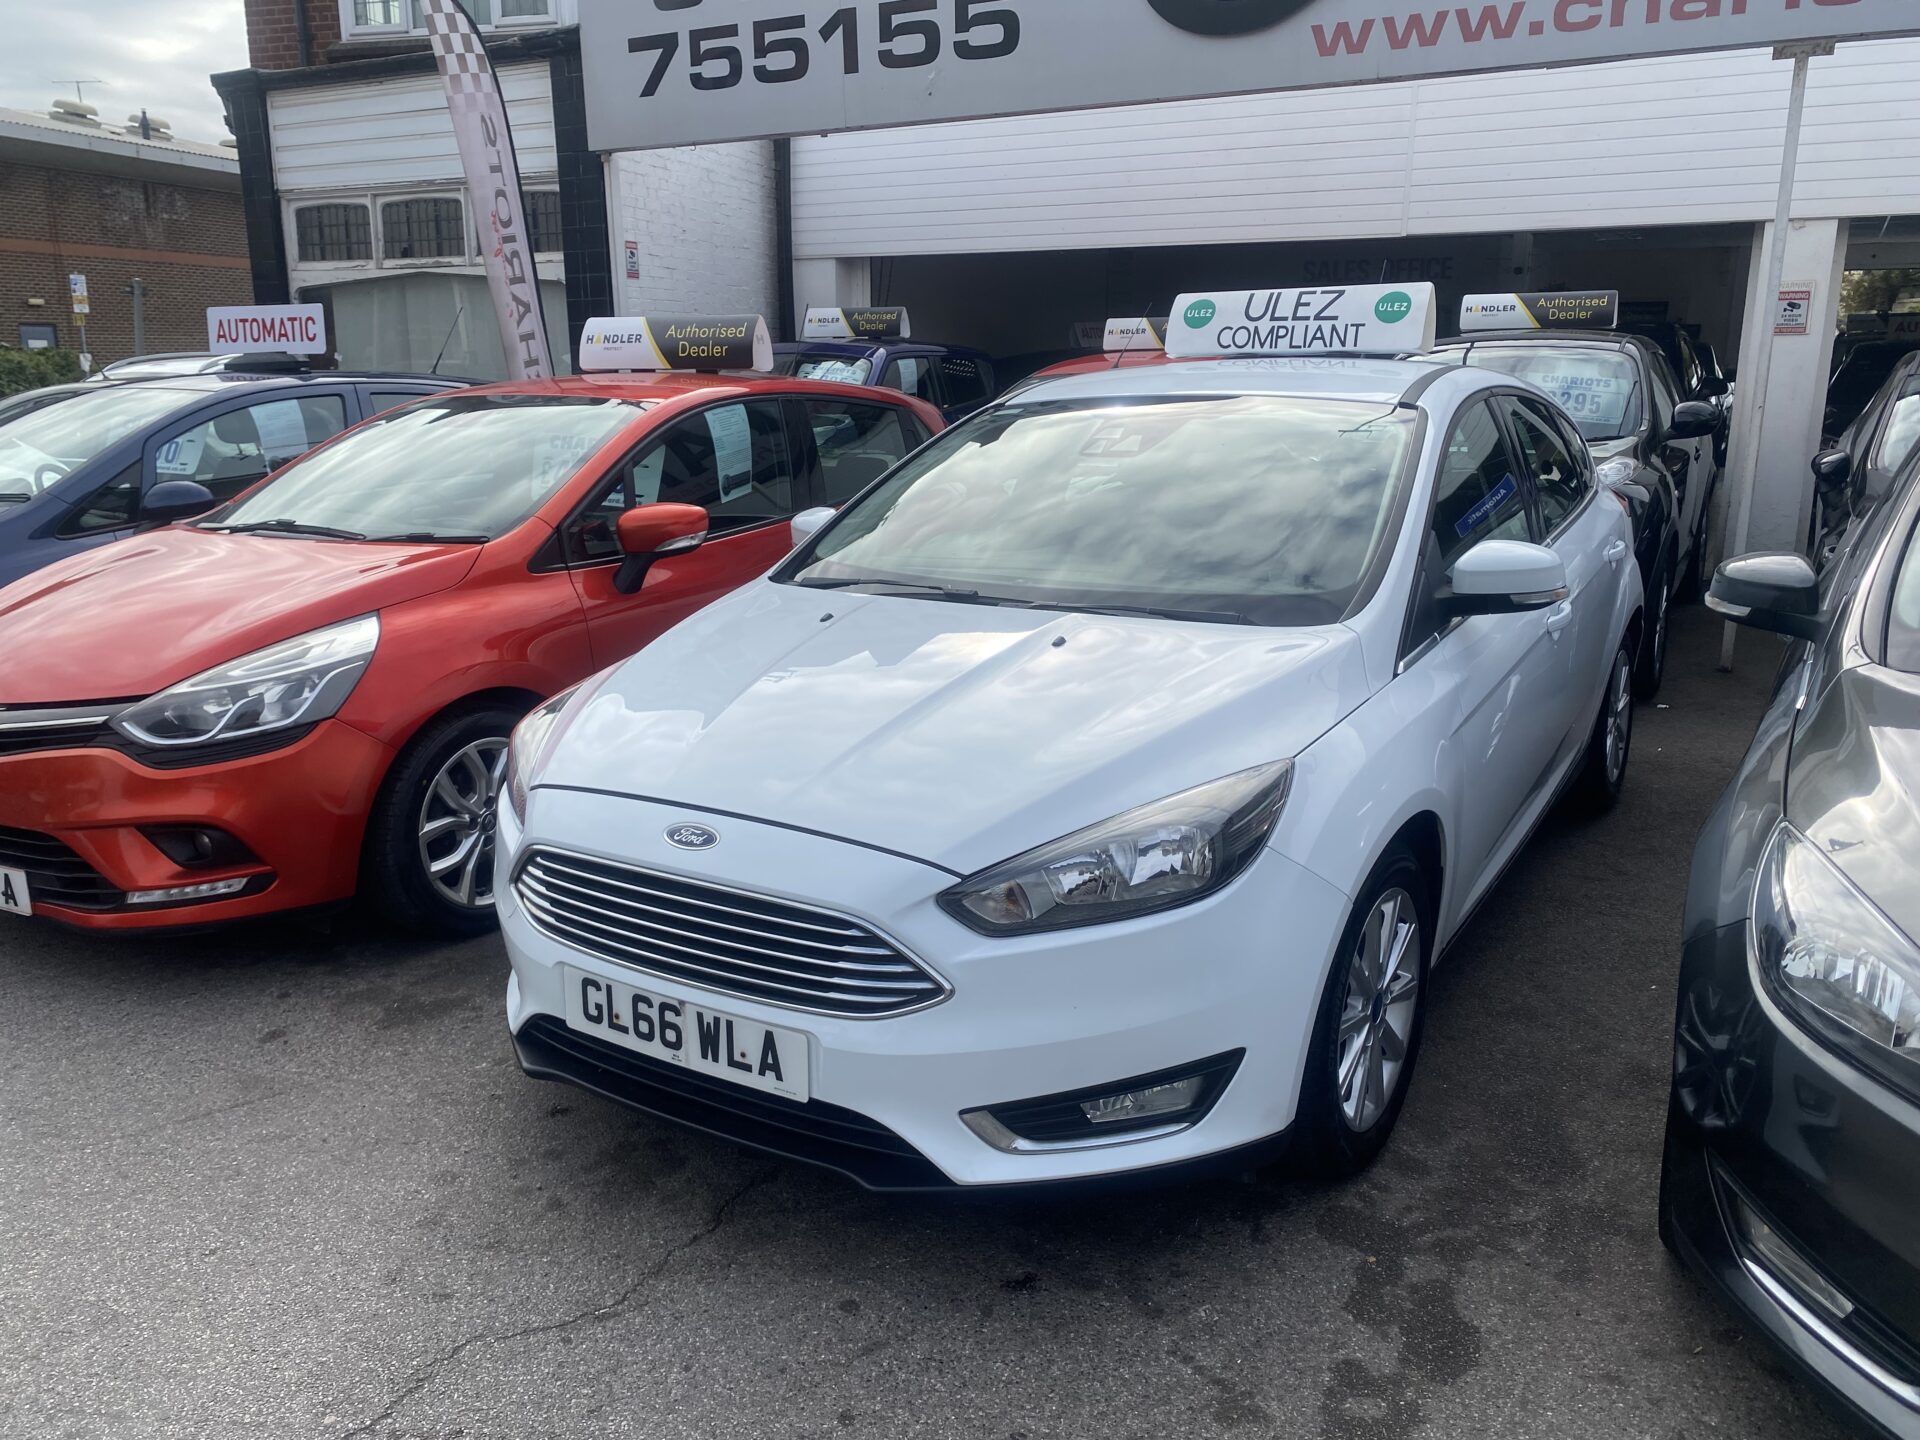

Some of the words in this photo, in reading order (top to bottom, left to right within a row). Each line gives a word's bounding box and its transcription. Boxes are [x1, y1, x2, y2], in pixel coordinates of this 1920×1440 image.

[1311, 0, 1862, 58] www.cha
[627, 0, 1020, 98] 755155
[1244, 290, 1346, 322] ULEZ
[1378, 301, 1409, 311] ULEZ
[1537, 296, 1608, 308] Authorised
[852, 311, 897, 321] Authorised
[1187, 309, 1213, 317] ULEZ
[1549, 308, 1592, 320] Dealer
[216, 316, 317, 343] AUTOMATIC
[665, 322, 747, 338] Authorised
[859, 321, 887, 331] Dealer
[1216, 323, 1366, 350] COMPLIANT
[678, 341, 728, 357] Dealer
[1542, 374, 1612, 388] CHARIOTS
[673, 828, 704, 845] Ford
[581, 976, 683, 1052] GL66
[696, 1010, 783, 1083] WLA
